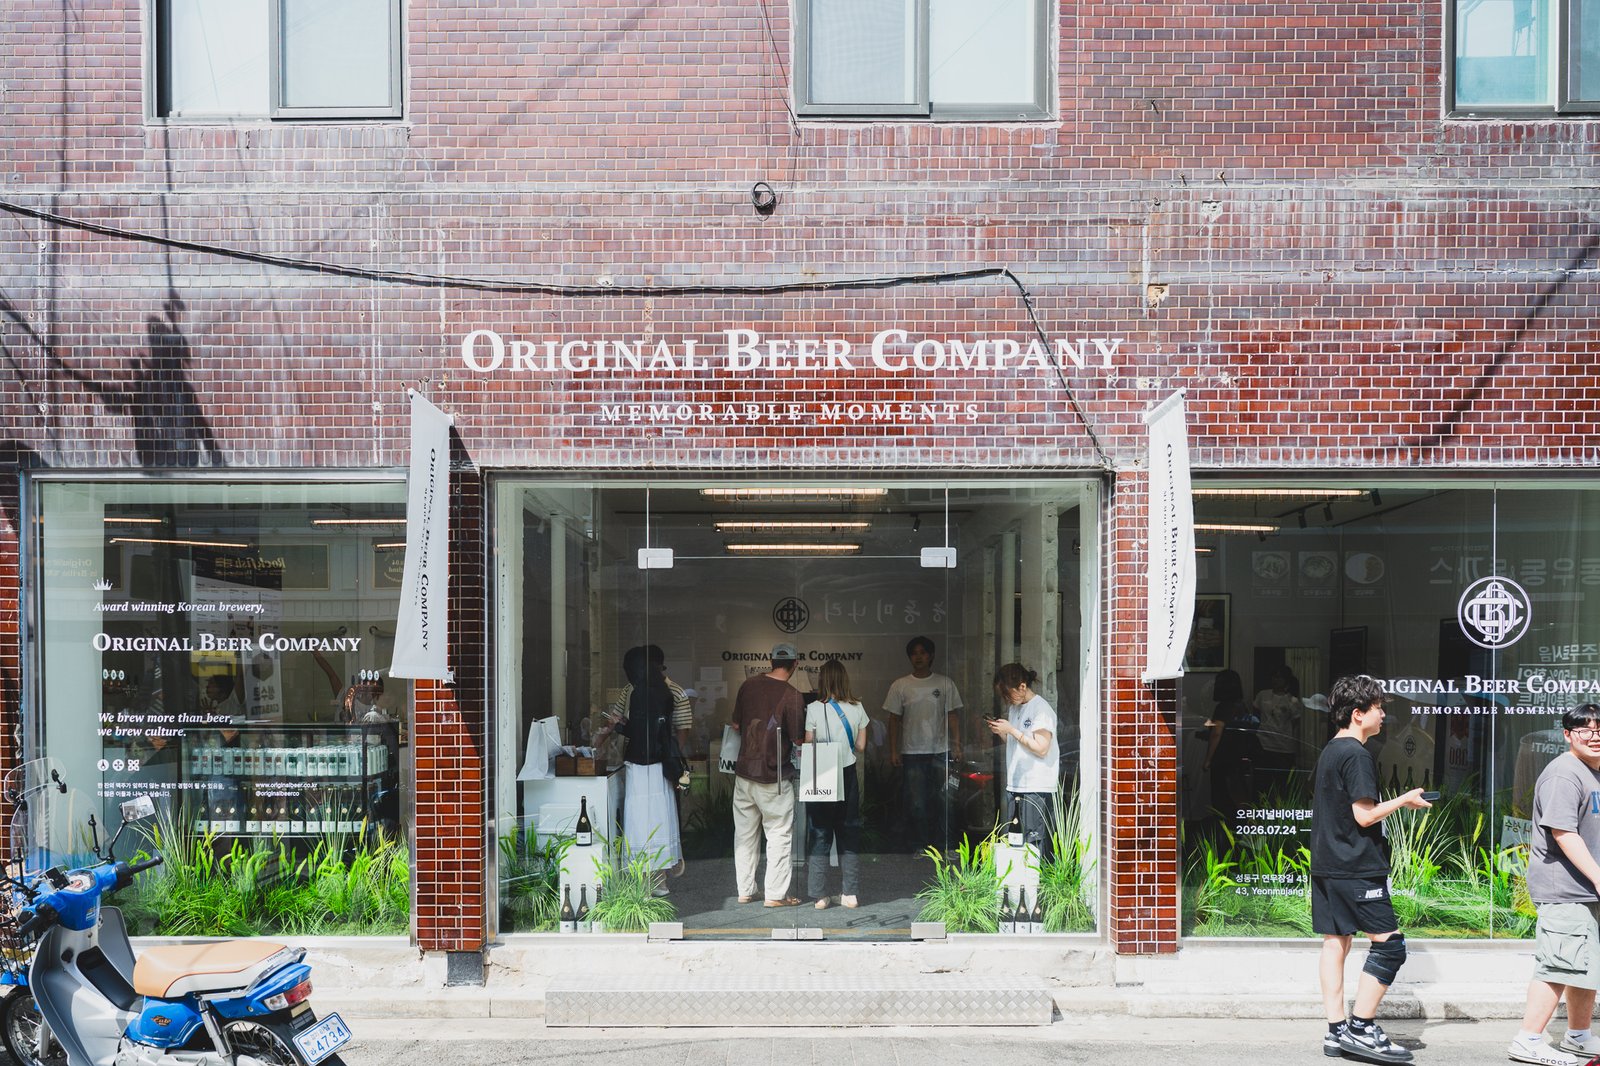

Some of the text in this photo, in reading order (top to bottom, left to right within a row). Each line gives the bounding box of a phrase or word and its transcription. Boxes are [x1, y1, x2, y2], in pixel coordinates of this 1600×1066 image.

[461, 329, 1124, 372] ORIGINAL BEER COMPANY
[600, 404, 979, 421] MEMORABLE MOMENTS
[93, 602, 265, 614] Award winning Korean brewery,
[420, 574, 429, 651] COMPANY
[93, 633, 361, 652] ORIGINAL BEER COMPANY
[809, 650, 863, 661] COMPANY
[1356, 675, 1459, 694] RIGINAL
[1464, 675, 1521, 693] BEER
[1411, 706, 1498, 715] MEMORABLE
[98, 713, 233, 725] We brew more than beer,
[97, 727, 187, 737] we brew culture.
[1236, 825, 1296, 835] 2026.07.24
[1296, 875, 1308, 883] 43
[1235, 887, 1249, 897] 43,
[1365, 888, 1383, 899] NIKE
[316, 1026, 345, 1052] 4734
[1540, 1057, 1568, 1066] crocs
